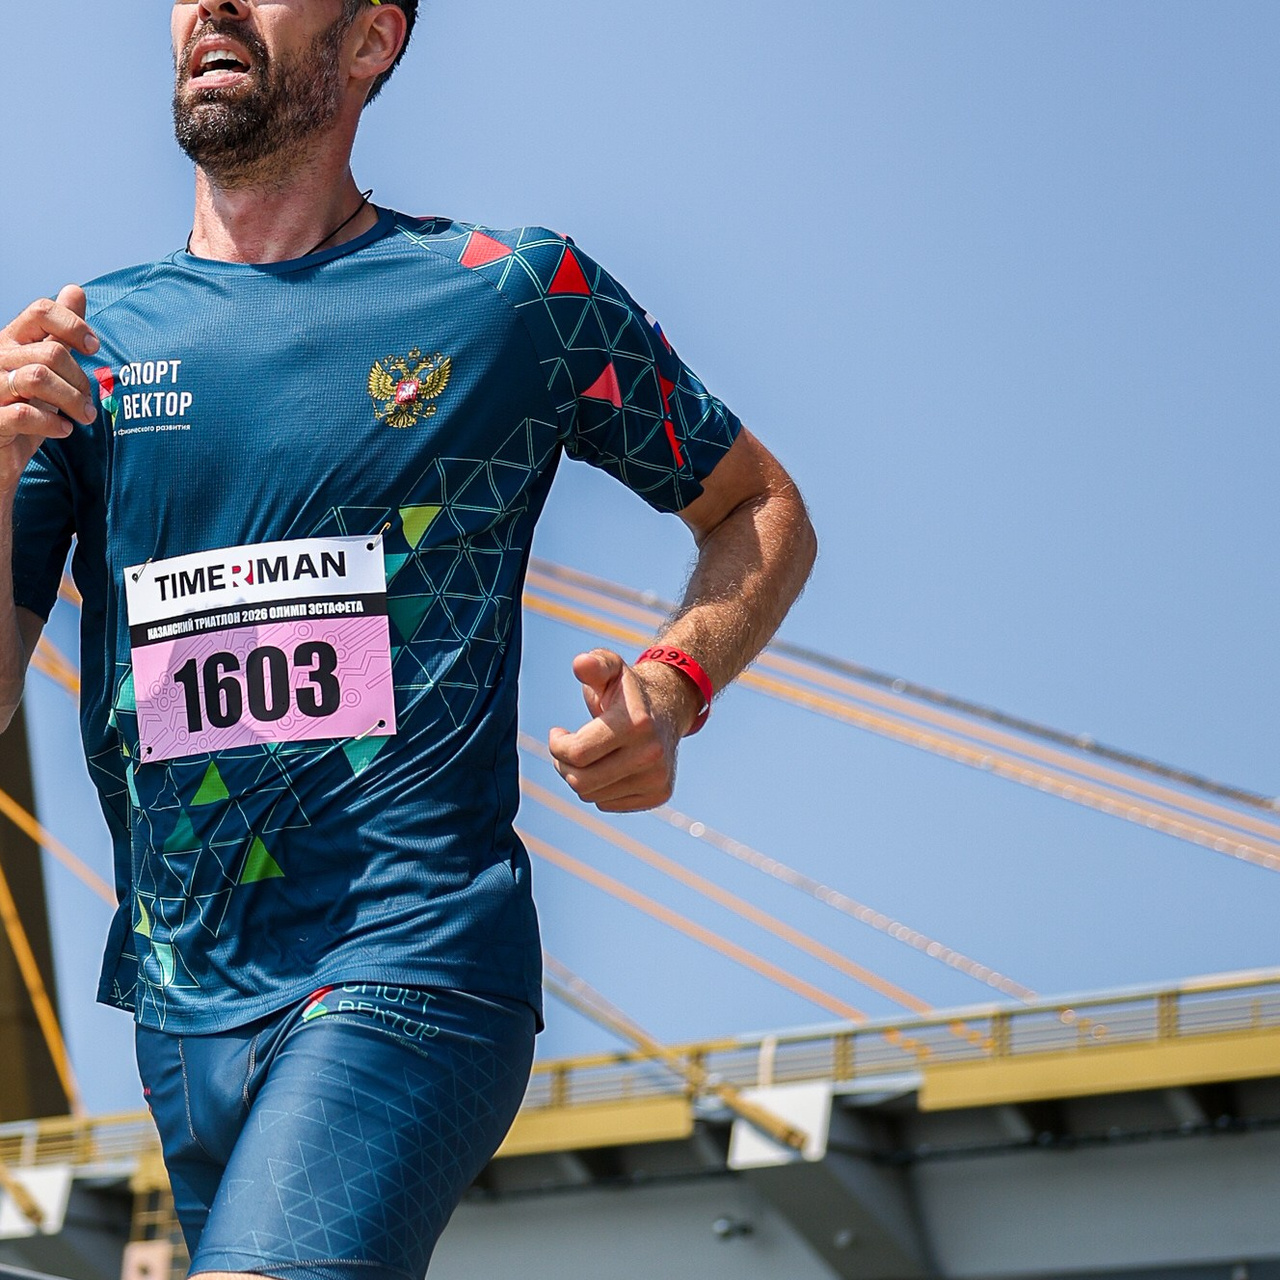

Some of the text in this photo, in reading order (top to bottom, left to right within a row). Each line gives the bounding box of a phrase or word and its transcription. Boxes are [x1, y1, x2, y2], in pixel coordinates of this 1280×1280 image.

[119, 360, 182, 387] СПОРТ
[123, 391, 192, 420] ВЕКТОР
[155, 424, 191, 433] развития
[147, 600, 364, 640] КАЗАНСКИЙ ТРИАТЛОН 2026 ОЛИМП ЭСТАФЕТА
[174, 641, 340, 733] 1603
